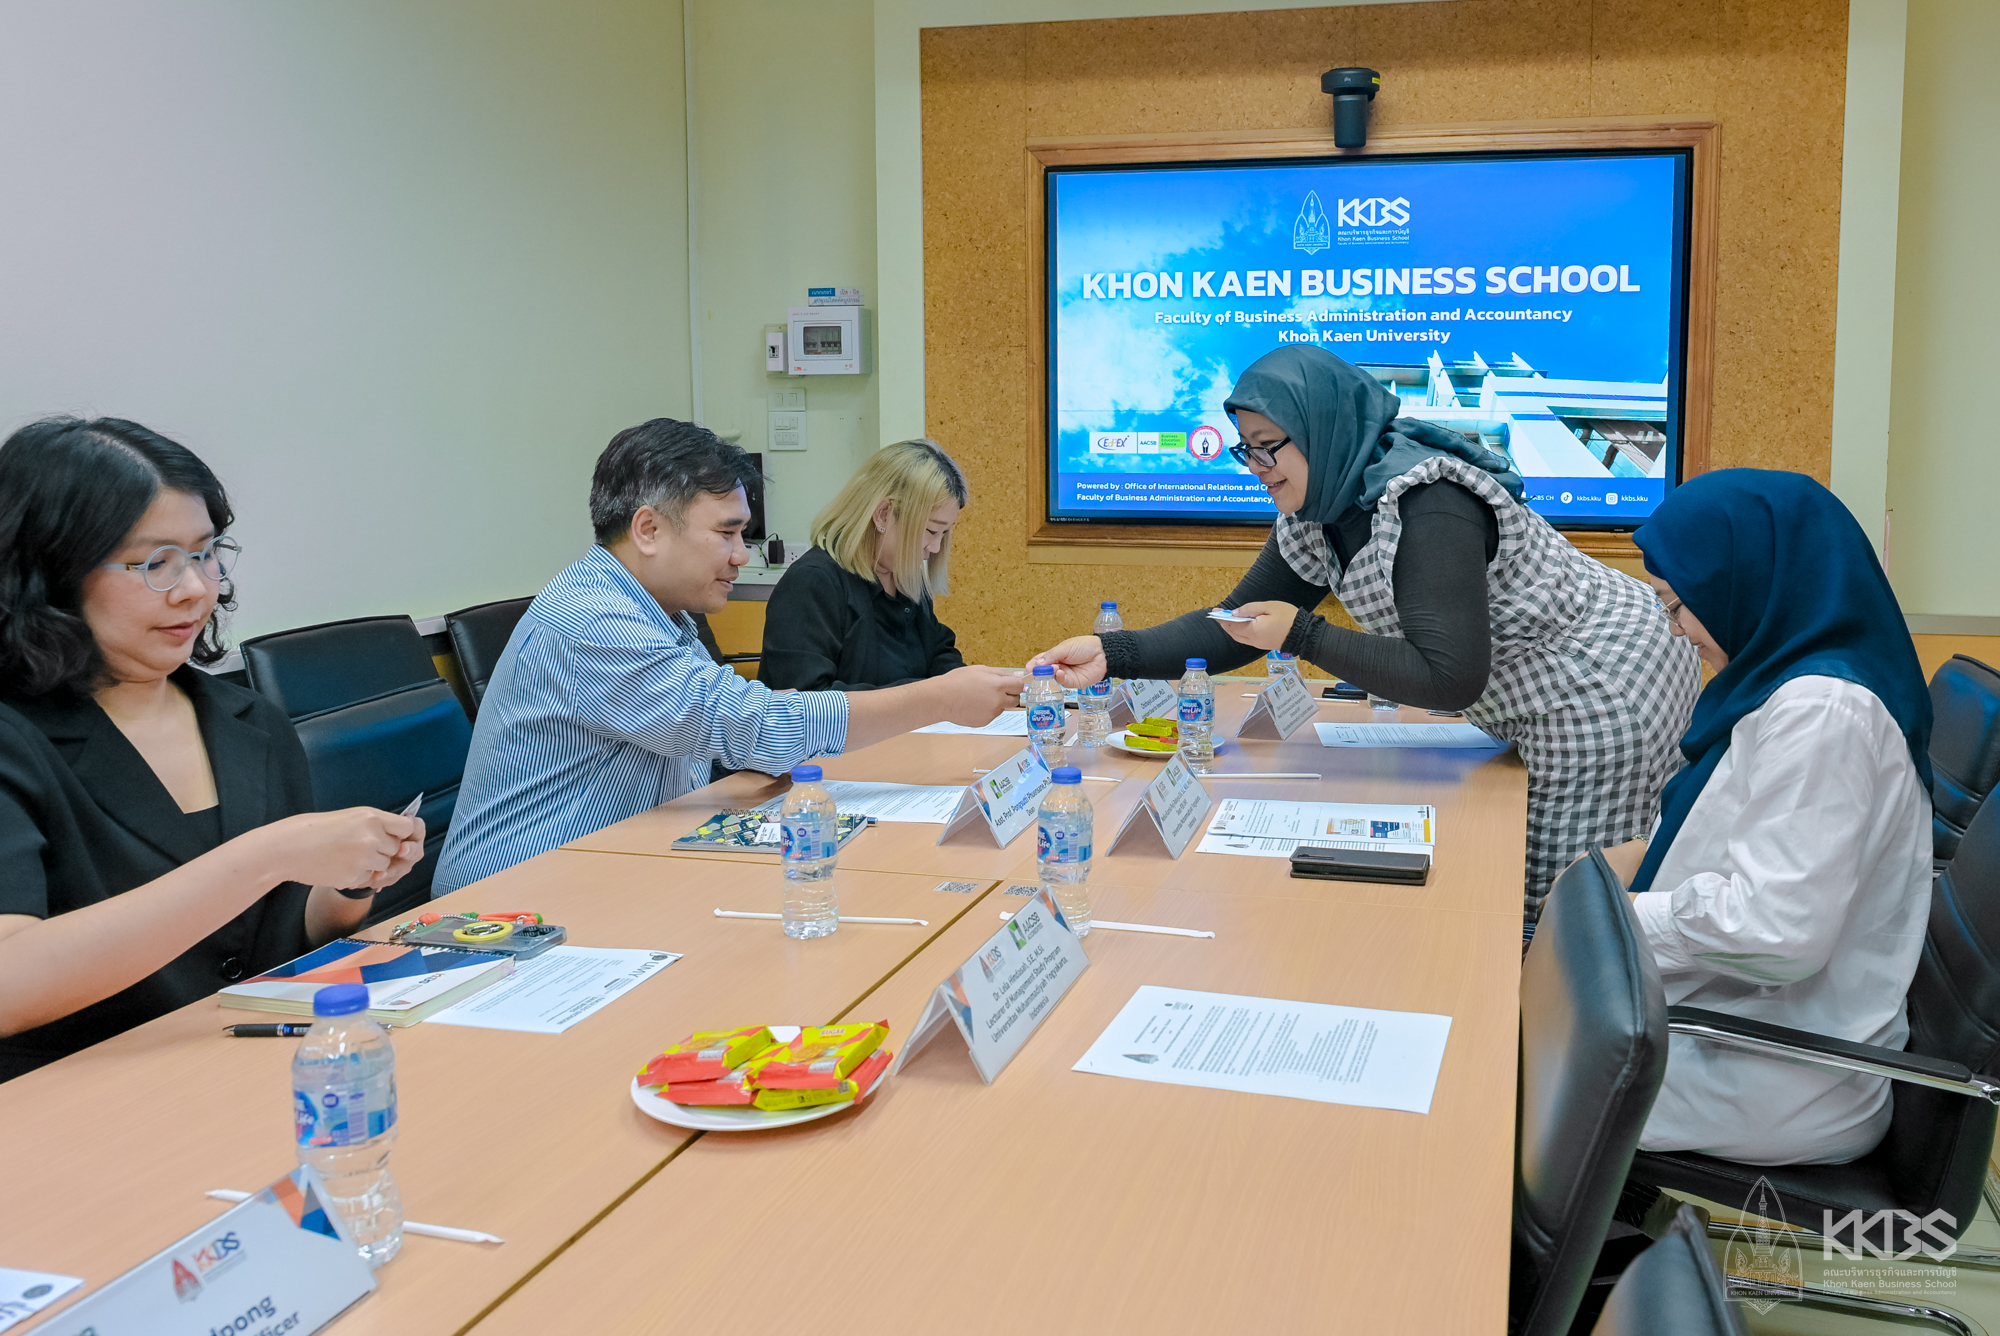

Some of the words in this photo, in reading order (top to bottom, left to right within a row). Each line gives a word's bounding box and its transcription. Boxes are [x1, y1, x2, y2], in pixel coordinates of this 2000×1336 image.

[1338, 197, 1410, 227] KKBS
[1083, 272, 1183, 299] KHON
[1192, 270, 1291, 298] KAEN
[1301, 267, 1476, 296] BUSINESS
[1485, 265, 1641, 294] SCHOOL
[1155, 311, 1212, 326] Faculty
[1215, 310, 1231, 323] of
[1234, 310, 1302, 323] Business
[1306, 309, 1427, 322] Administration
[1430, 308, 1460, 321] and
[1465, 308, 1572, 322] Accountancy
[1278, 330, 1319, 342] Khon
[1323, 330, 1362, 342] Kaen
[1366, 328, 1451, 344] University
[1077, 494, 1103, 502] Faculty
[1149, 494, 1205, 502] Administration
[1110, 482, 1120, 491] by
[1125, 482, 1146, 490] Office
[1149, 482, 1156, 490] of
[1207, 483, 1243, 491] Relations
[1021, 911, 1040, 934] AACSB
[986, 1004, 1006, 1028] Lecturer
[1004, 998, 1011, 1008] of
[1009, 972, 1035, 1004] Management
[1033, 960, 1046, 978] Study
[1044, 944, 1061, 966] Program
[993, 989, 1001, 1001] Dr.
[999, 980, 1010, 994] Lela
[991, 1010, 1017, 1043] Universitas
[1016, 977, 1048, 1016] Muhammadiyah
[1029, 994, 1048, 1020] Indonesia
